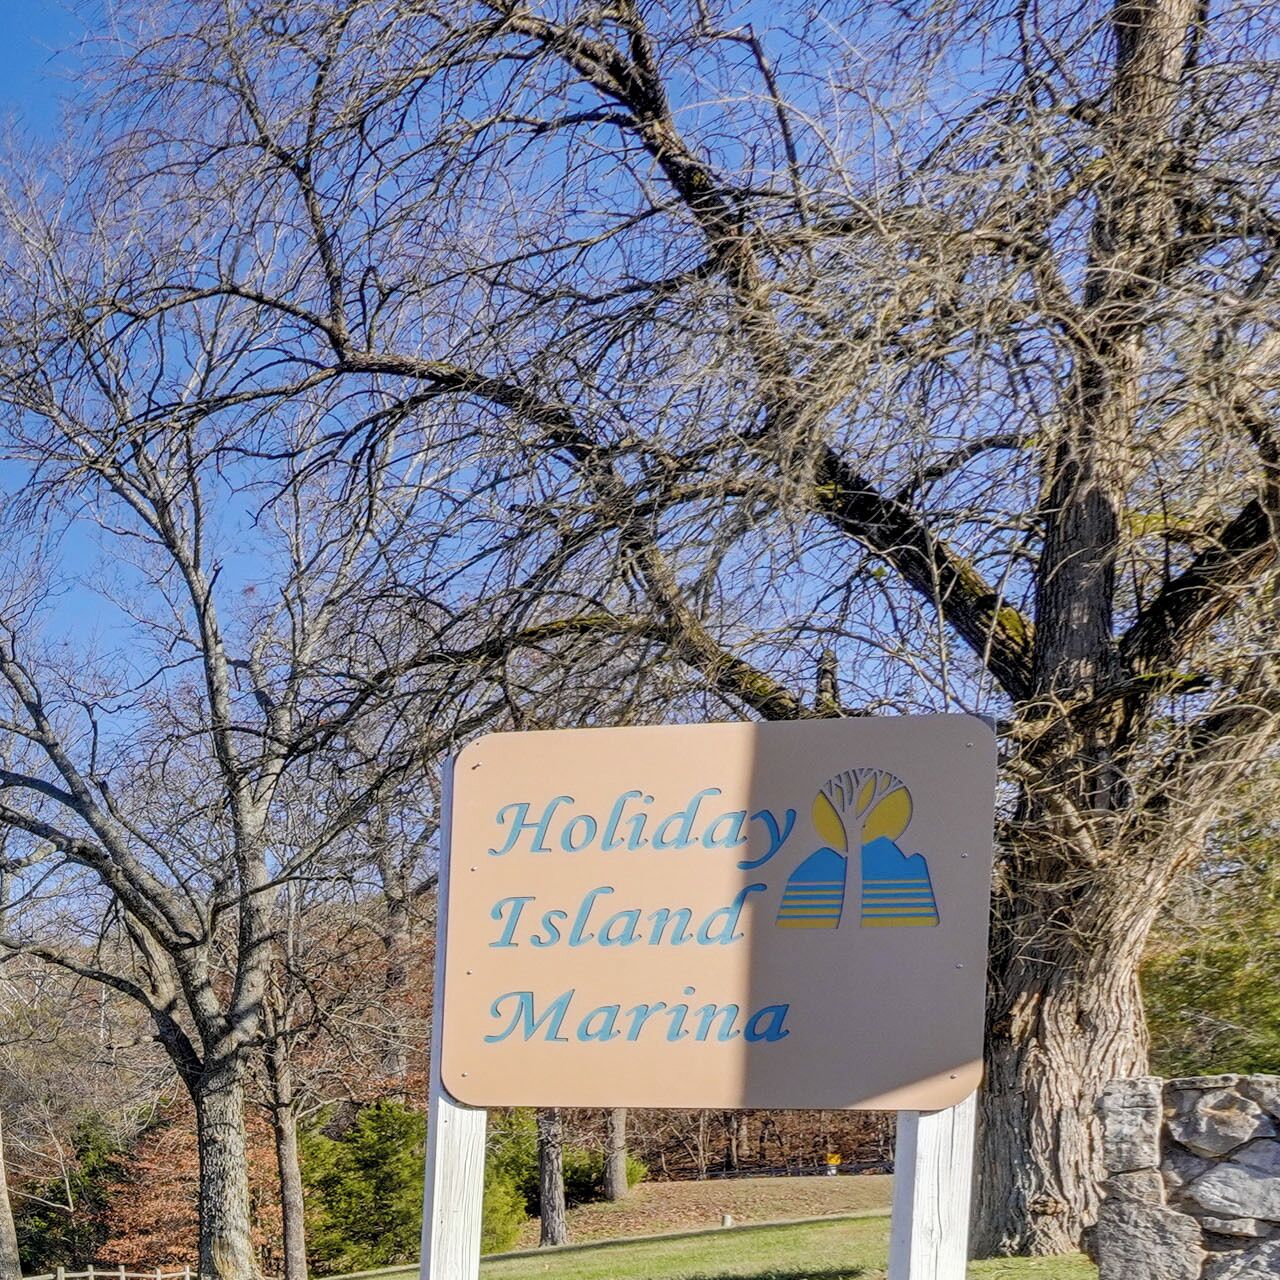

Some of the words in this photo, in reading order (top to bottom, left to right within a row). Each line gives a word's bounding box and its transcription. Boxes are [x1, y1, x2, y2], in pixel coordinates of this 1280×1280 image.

[487, 787, 797, 870] Holiday
[489, 883, 768, 948] Island
[483, 986, 791, 1044] Marina
